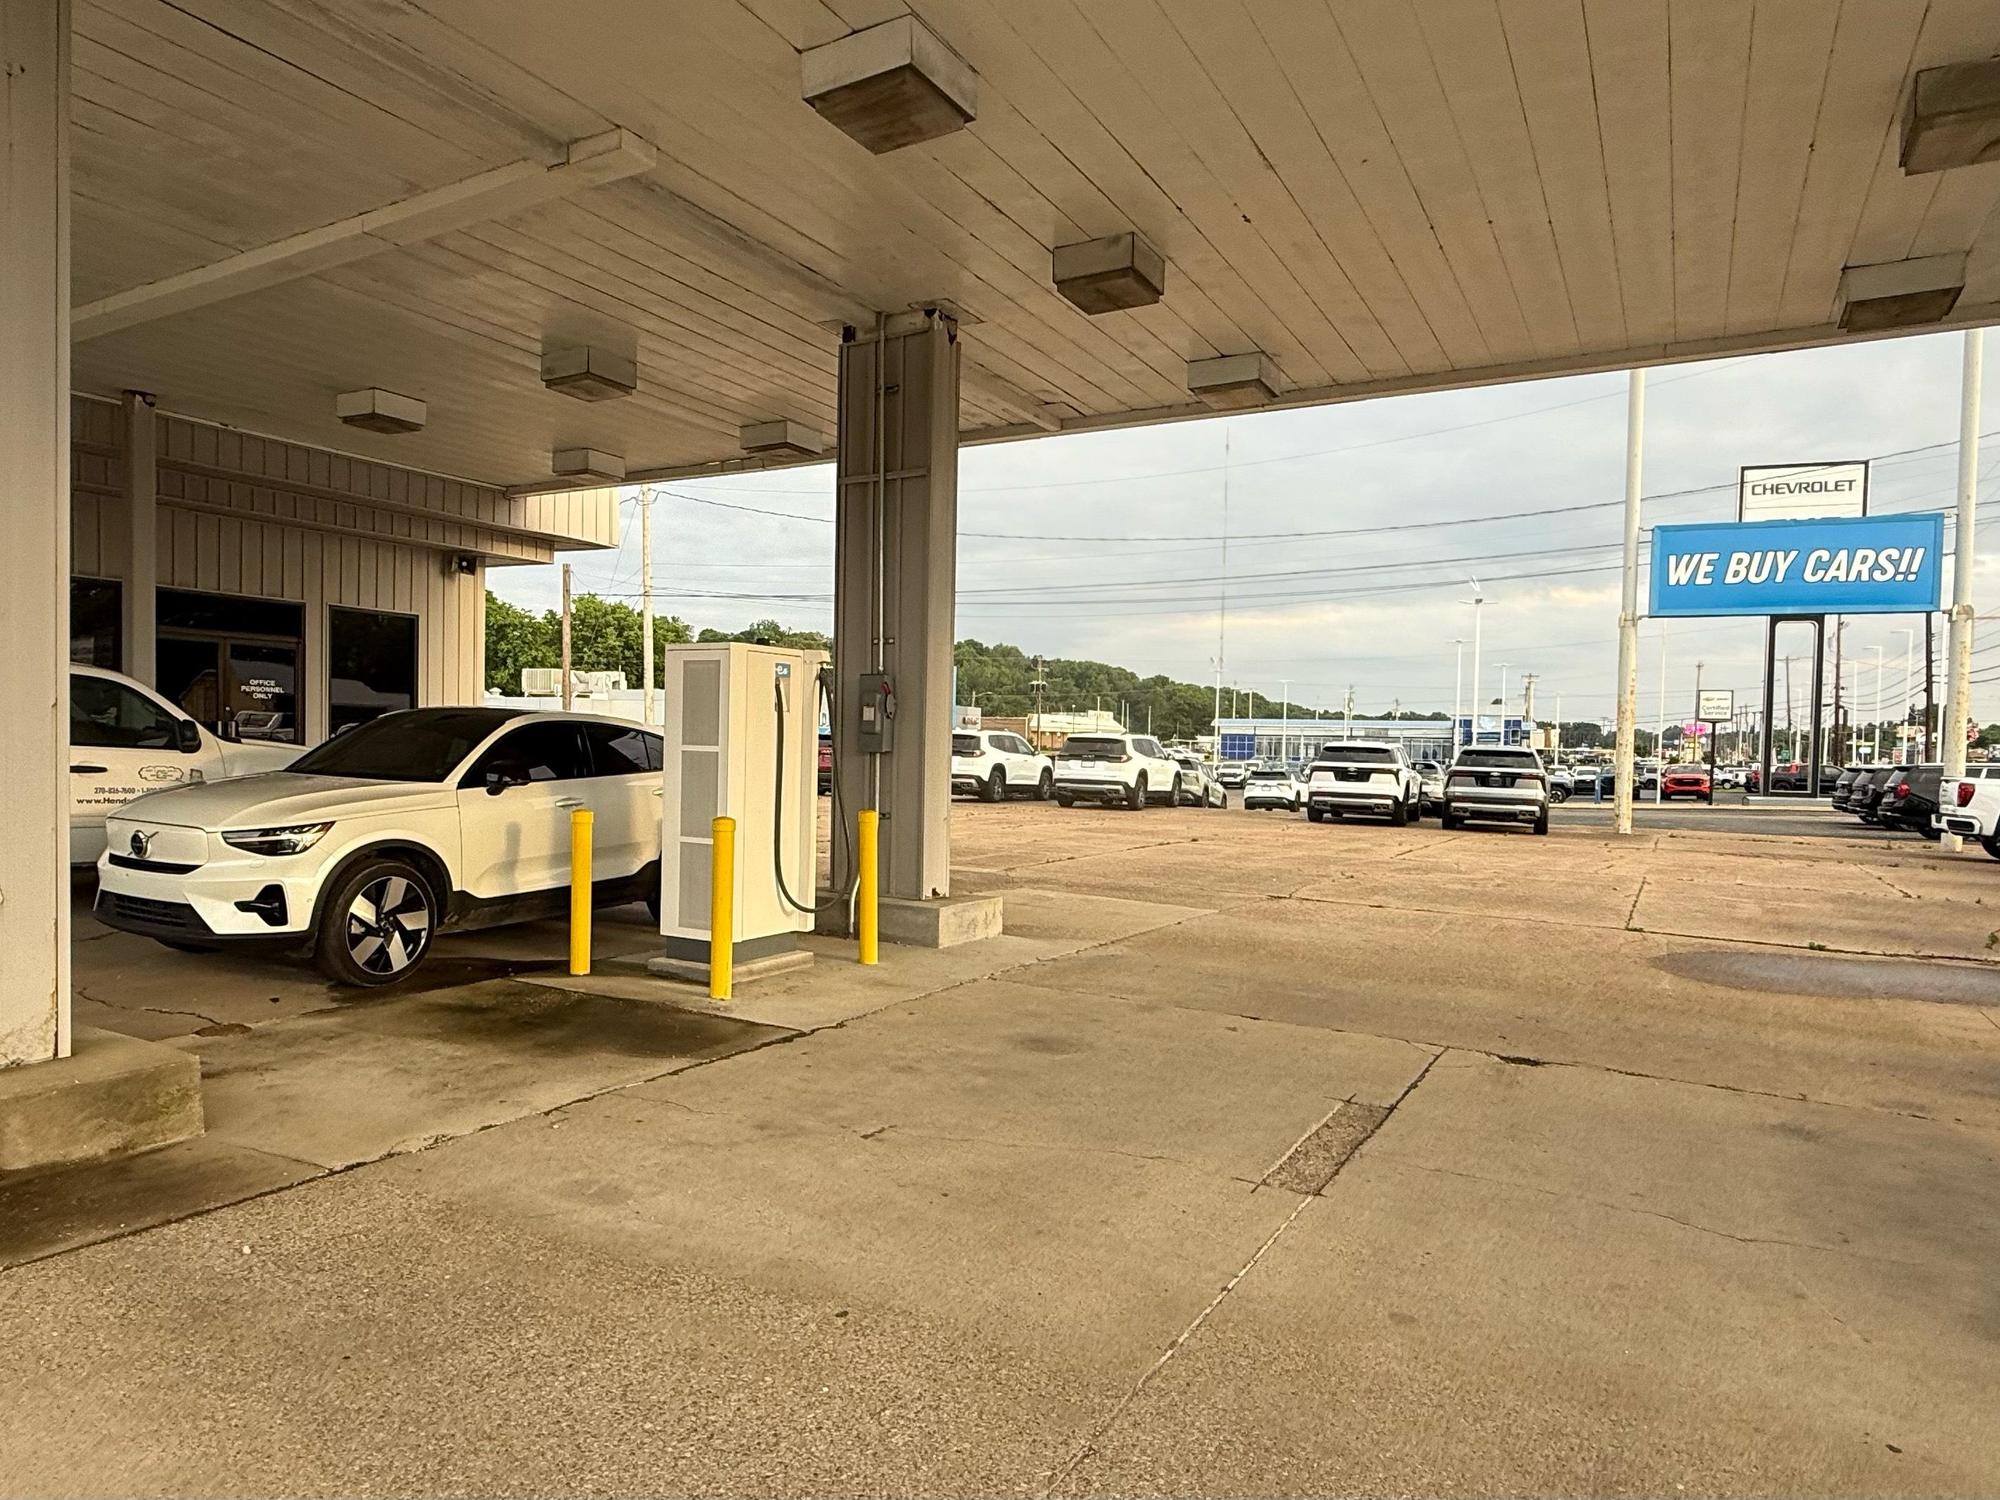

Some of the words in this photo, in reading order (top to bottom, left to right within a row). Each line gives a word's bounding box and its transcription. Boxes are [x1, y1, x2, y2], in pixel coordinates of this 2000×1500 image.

[1751, 479, 1857, 496] CHEVROLET
[1667, 552, 1720, 586] WE
[1723, 549, 1799, 585] BUY
[1802, 547, 1926, 584] CARS!!
[240, 685, 285, 694] PERSONNEL
